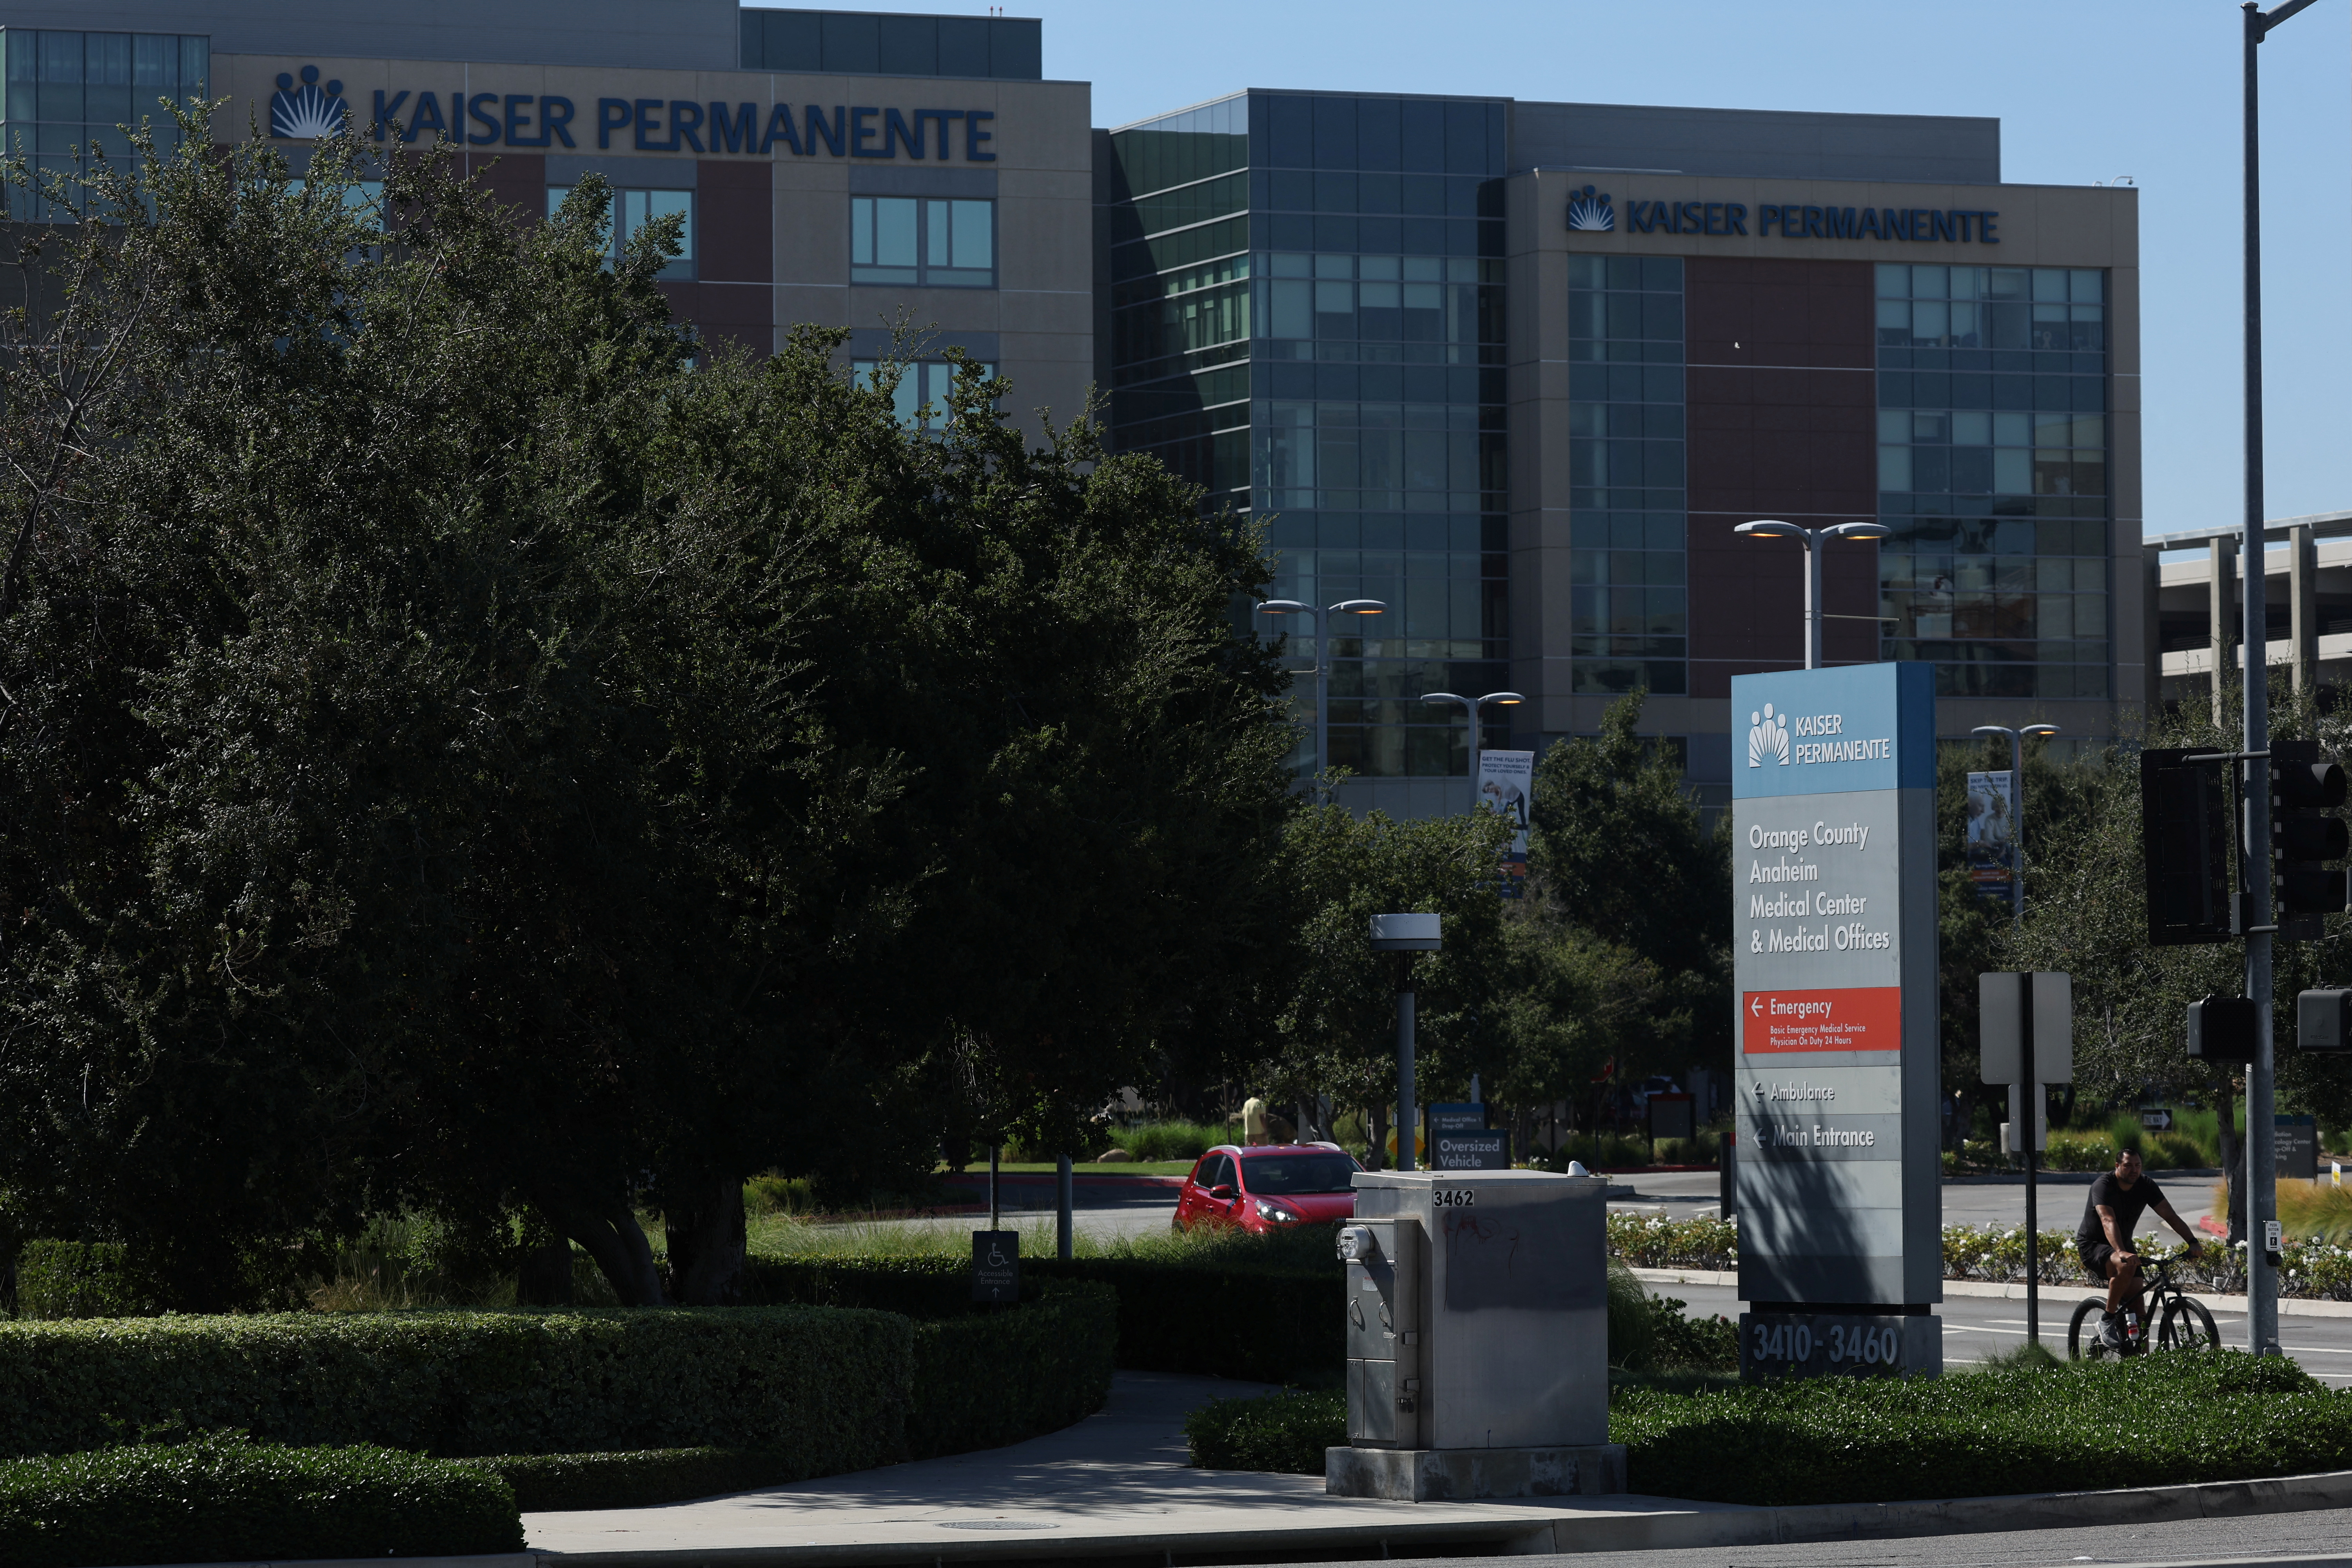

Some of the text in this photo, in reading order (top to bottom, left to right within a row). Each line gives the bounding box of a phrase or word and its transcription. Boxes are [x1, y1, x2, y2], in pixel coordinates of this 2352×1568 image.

[373, 90, 996, 162] KAISER PERMANENTE
[1626, 200, 2000, 244] KAISER PERMANENTE
[1796, 715, 1842, 737] KAISER
[1797, 739, 1890, 764] PERMANENTE
[1750, 821, 1869, 854] Orange County
[1750, 856, 1818, 884] Anaheim
[1750, 890, 1867, 918] Medical Center
[1751, 923, 1889, 953] & Medical Offices
[1771, 998, 1832, 1019] Emergency
[1770, 1023, 1866, 1036] Basic Emergency Medical Service
[1770, 1036, 1851, 1048] Physician On Duty 24 Hours
[1771, 1081, 1835, 1101] Ambulance
[1440, 1139, 1500, 1152] Oversized
[1773, 1125, 1875, 1147] Main Entrance
[1440, 1154, 1482, 1167] Vehicle
[1434, 1191, 1474, 1207] 3462
[1753, 1324, 1898, 1365] 3410-3460
